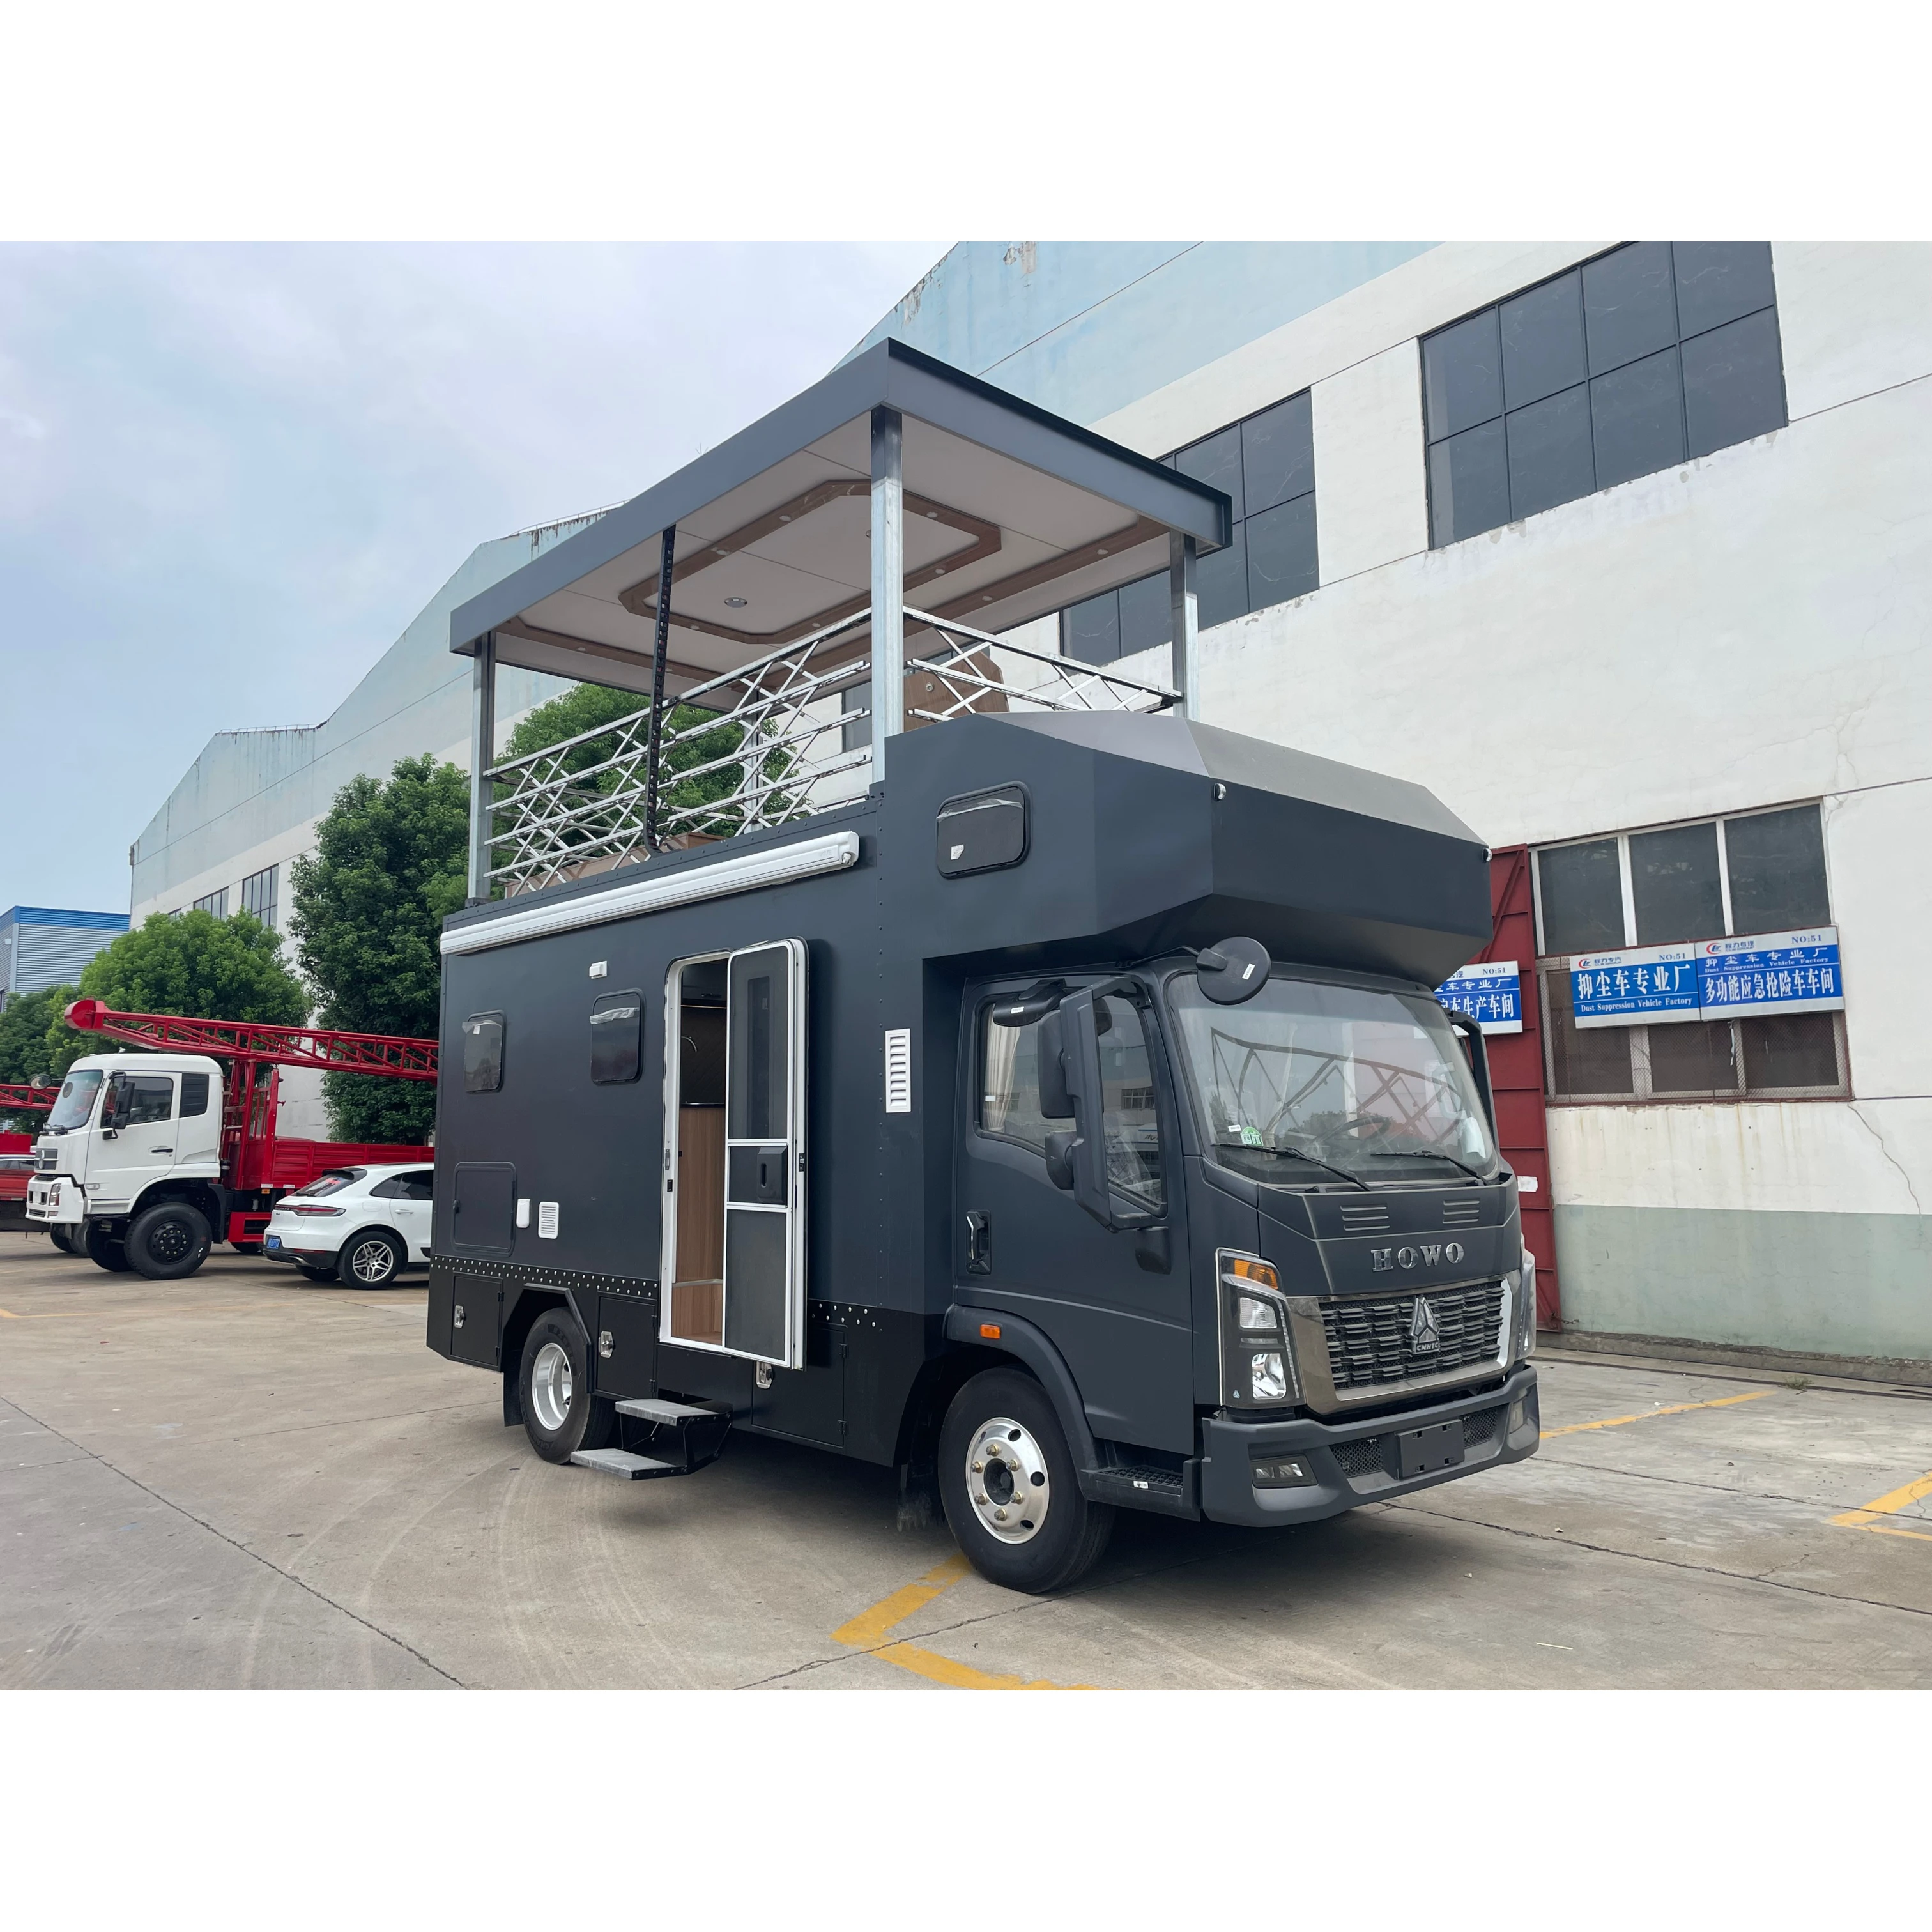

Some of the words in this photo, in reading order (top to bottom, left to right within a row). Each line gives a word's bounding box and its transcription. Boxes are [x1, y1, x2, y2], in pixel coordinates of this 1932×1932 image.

[1791, 935, 1821, 944] NO:51
[1659, 953, 1686, 961] NO:51
[1705, 947, 1828, 967] 抑尘车专业厂
[1482, 967, 1506, 976] NO:51
[1577, 963, 1690, 1000] 抑尘车专业厂
[1705, 967, 1834, 1004] 多功能应急抢险车车间
[1581, 1004, 1595, 1013] Dust
[1597, 1001, 1636, 1012] Suppression
[1637, 999, 1662, 1008] Vehicle
[1665, 997, 1692, 1006] Factory
[1371, 1242, 1464, 1272] HOWO
[1416, 1342, 1439, 1351] CNHTC
